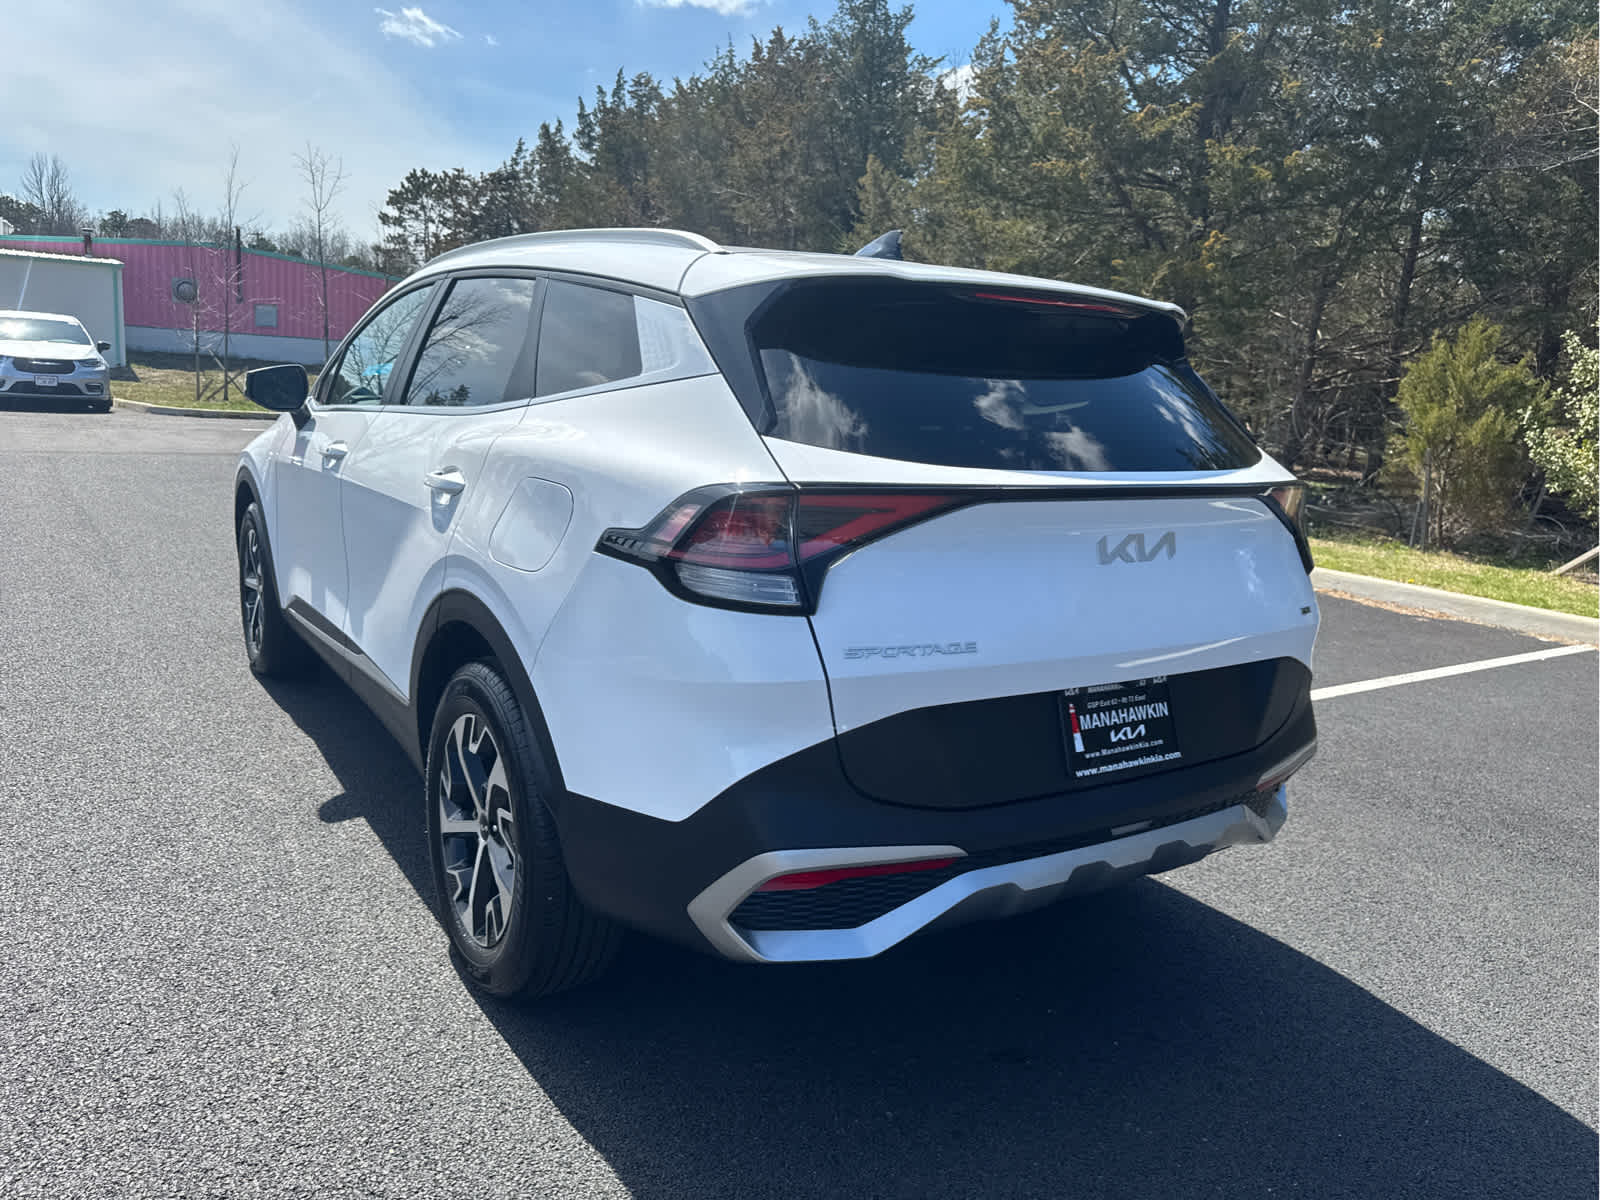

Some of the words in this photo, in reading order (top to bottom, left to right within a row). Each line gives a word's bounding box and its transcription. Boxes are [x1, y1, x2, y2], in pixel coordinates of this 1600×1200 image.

[842, 641, 977, 660] SPORTAGE
[1080, 702, 1169, 730] MANAHAWKIN
[1110, 724, 1146, 742] KIA
[1075, 751, 1182, 777] www.manahawkinkia.com
